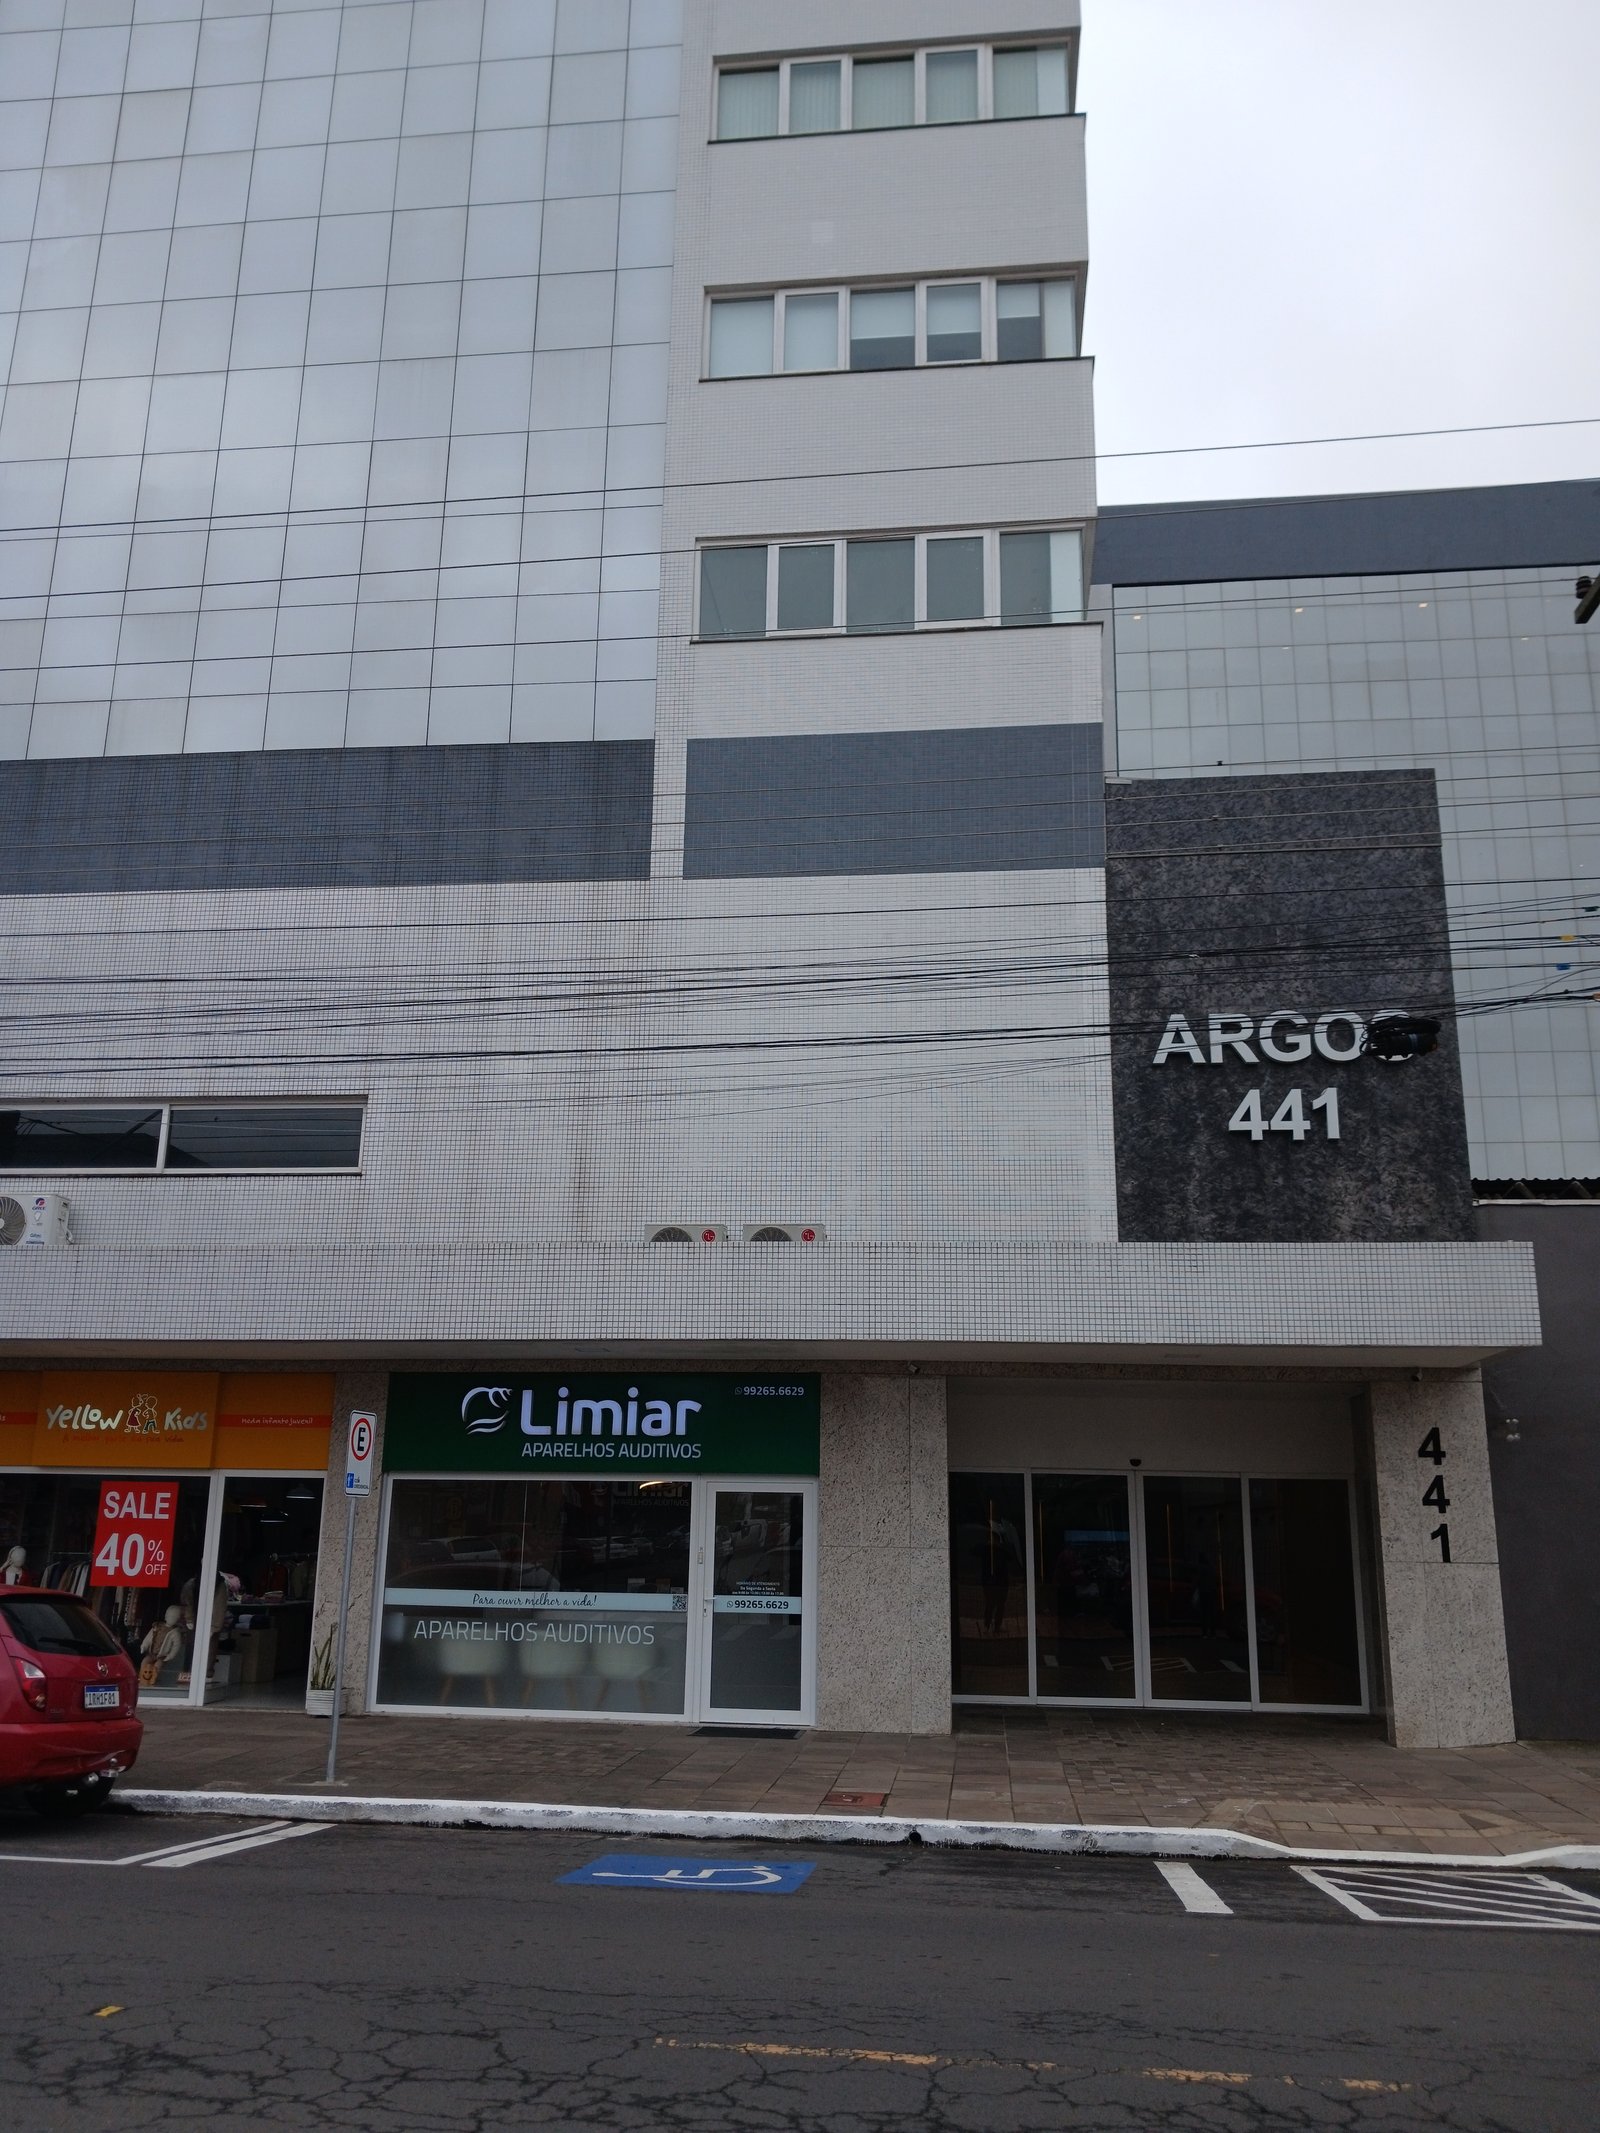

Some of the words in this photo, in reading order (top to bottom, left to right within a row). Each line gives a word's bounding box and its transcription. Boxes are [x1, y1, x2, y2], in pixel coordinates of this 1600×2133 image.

[1228, 1087, 1340, 1141] 441
[743, 1386, 804, 1396] 99265.6629
[520, 1386, 702, 1437] Limiar
[357, 1427, 366, 1452] E
[522, 1442, 615, 1458] APARELHOS
[618, 1443, 701, 1459] AUDITIVOS
[103, 1491, 171, 1519] SALE
[145, 1564, 167, 1575] OFF
[472, 1593, 495, 1605] Para
[498, 1596, 522, 1605] ouvir
[525, 1593, 560, 1606] melhor
[572, 1595, 597, 1607] vida!
[734, 1600, 789, 1609] 99265.6629
[414, 1620, 538, 1642] APARELHOS
[543, 1623, 655, 1645] AUDITIVOS
